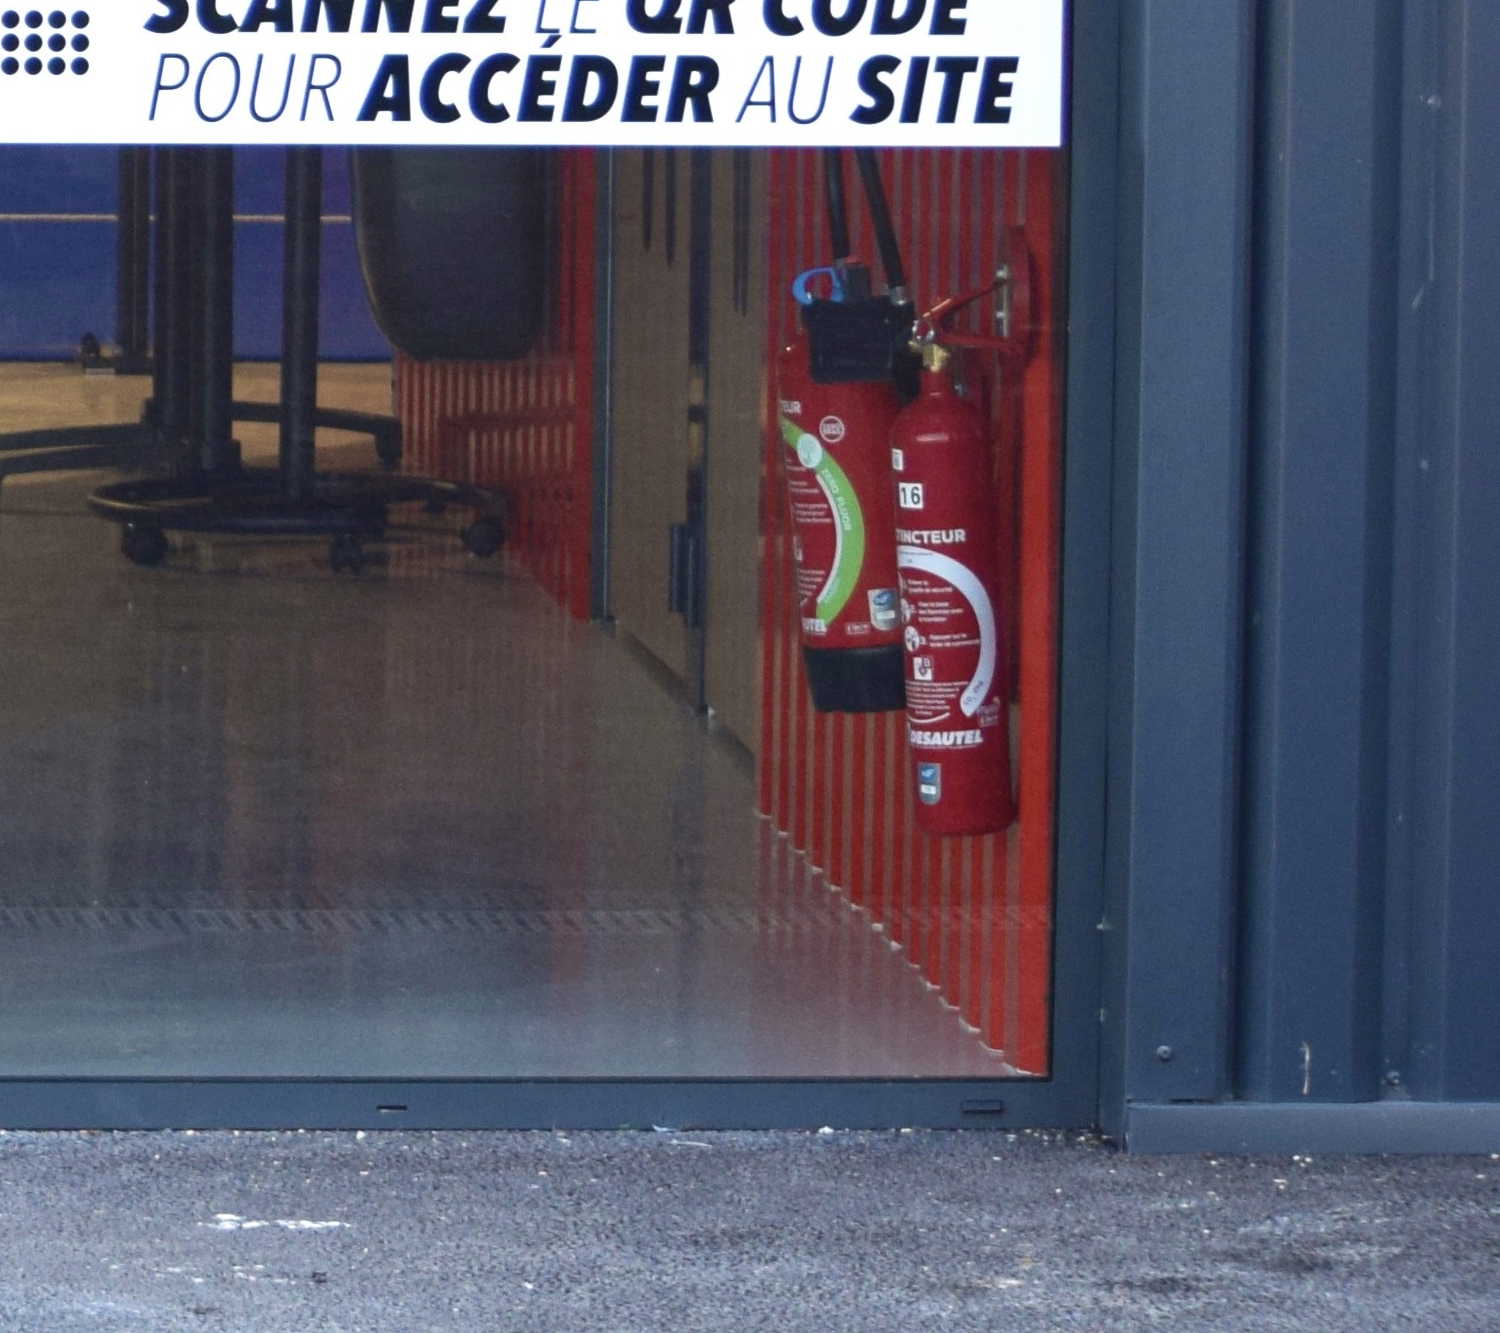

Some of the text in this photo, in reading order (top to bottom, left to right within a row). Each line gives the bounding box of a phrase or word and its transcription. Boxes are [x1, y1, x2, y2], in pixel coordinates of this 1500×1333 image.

[148, 35, 1021, 125] POUR ACCÉDER AU SITE
[901, 485, 921, 506] 16
